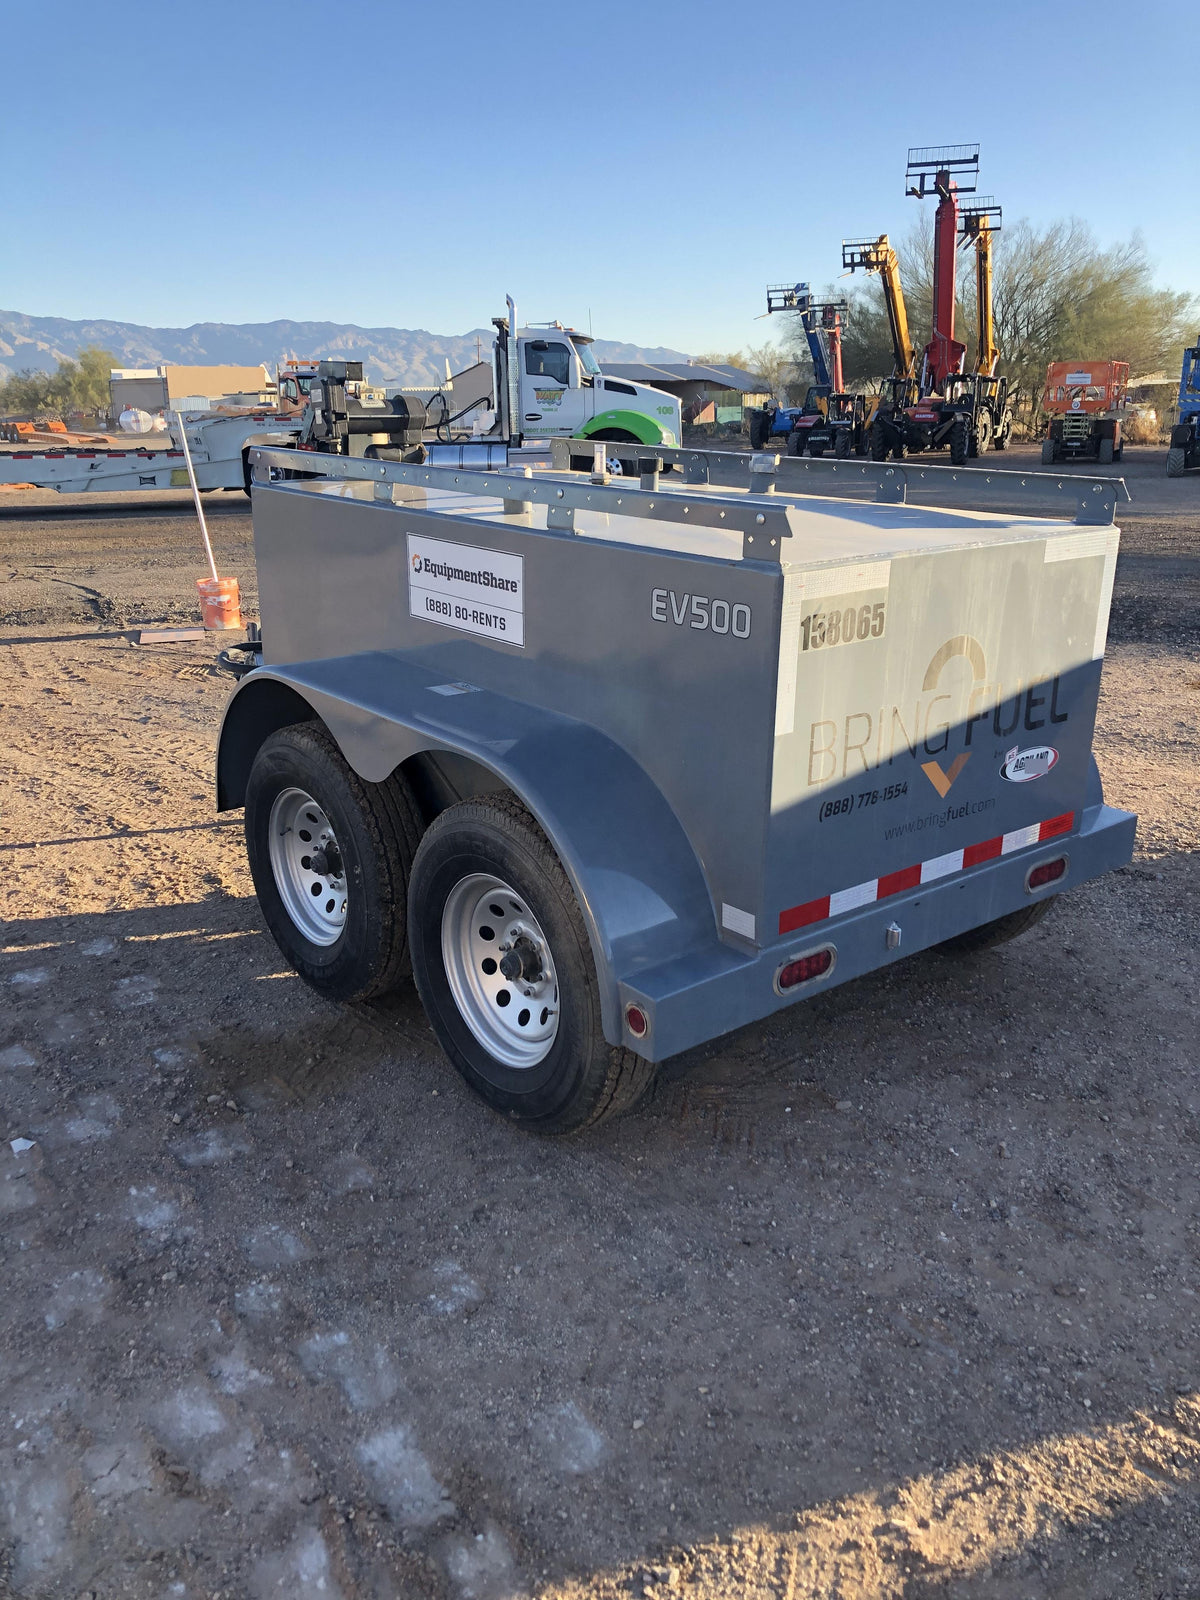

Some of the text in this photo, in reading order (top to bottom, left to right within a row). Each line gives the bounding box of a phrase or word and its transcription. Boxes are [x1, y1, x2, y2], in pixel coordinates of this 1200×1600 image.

[423, 557, 518, 593] EquipmentShare
[425, 597, 506, 631] (888) 80-RENTS
[651, 587, 752, 639] EV500
[801, 602, 886, 651] 158065
[808, 672, 1069, 786] BRING FUEL
[819, 794, 855, 823] (888)
[884, 798, 996, 841] www.bringfuel.com
